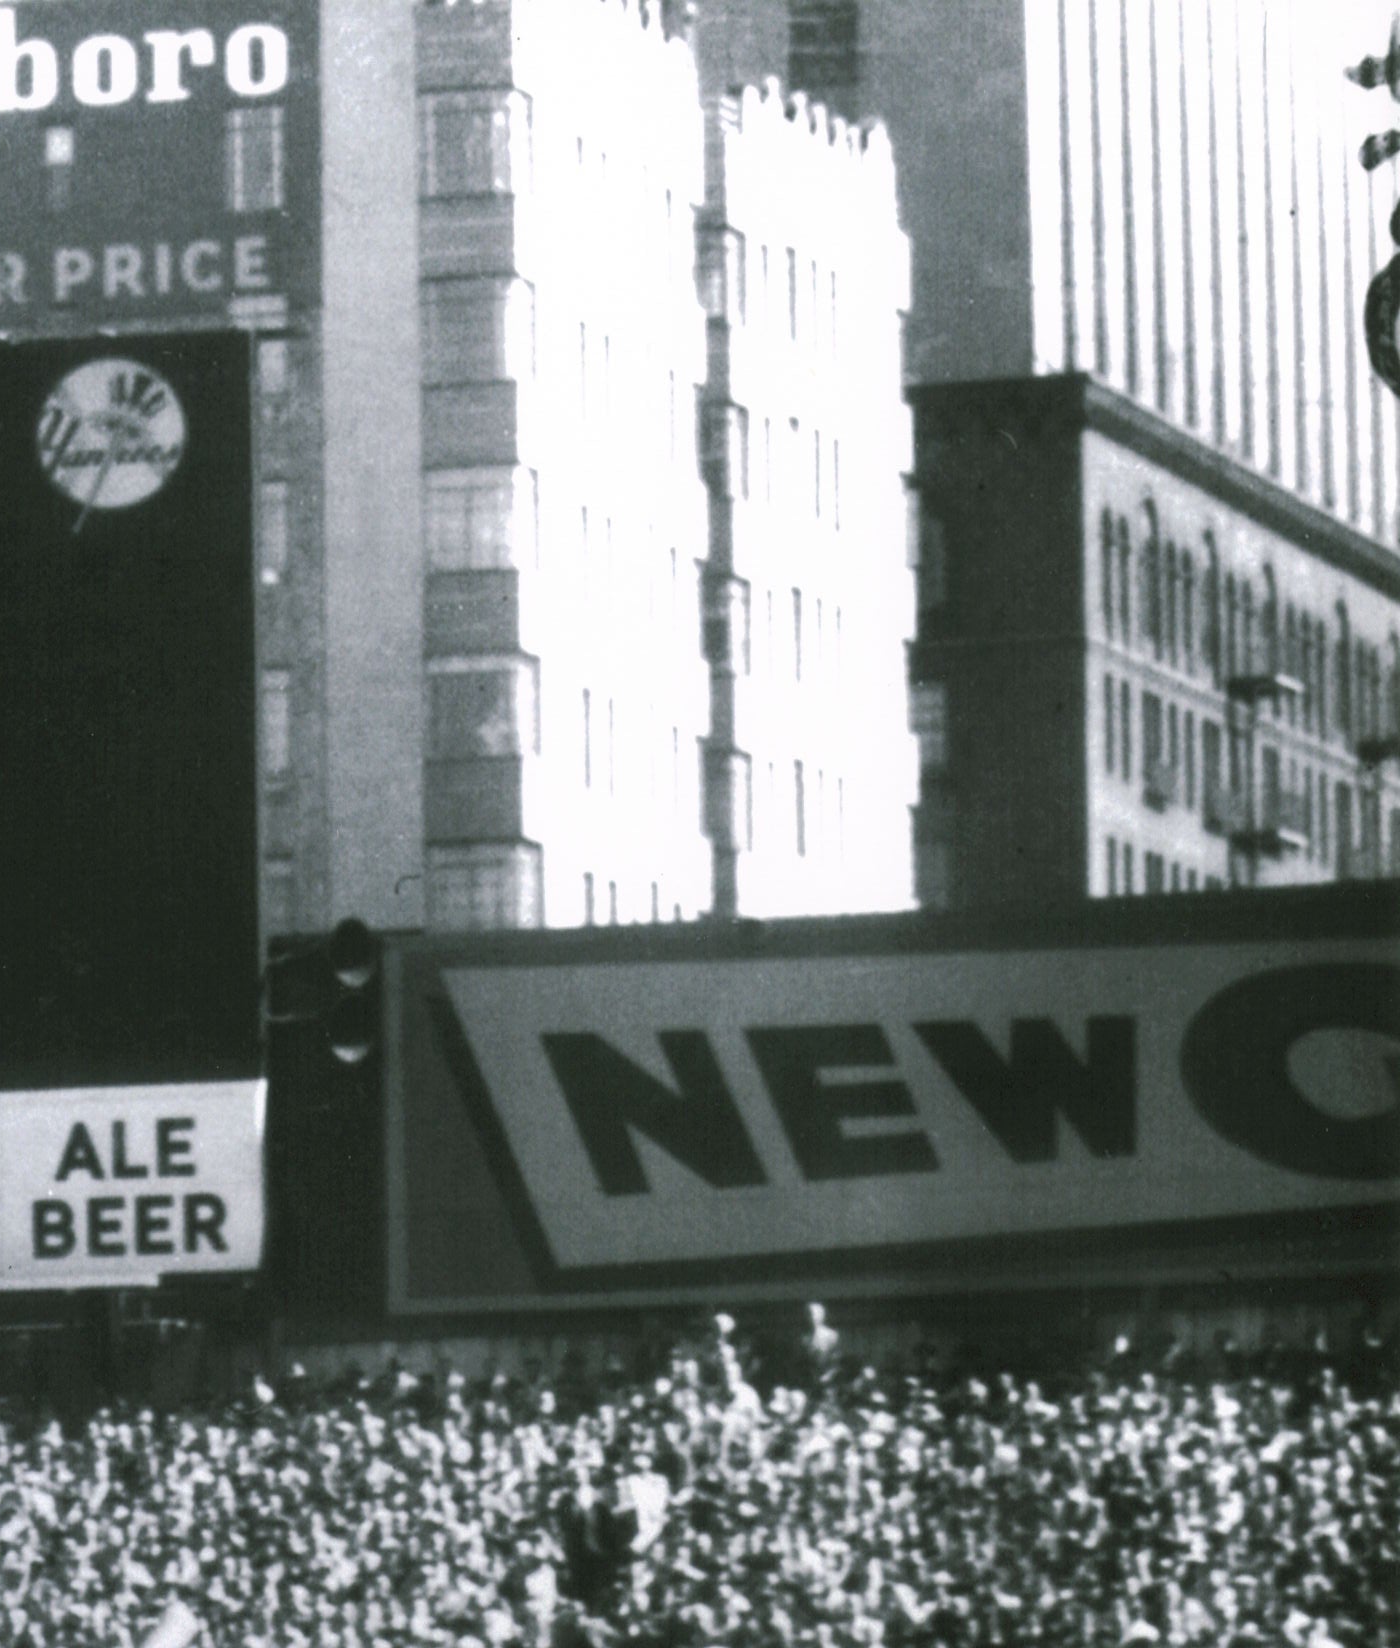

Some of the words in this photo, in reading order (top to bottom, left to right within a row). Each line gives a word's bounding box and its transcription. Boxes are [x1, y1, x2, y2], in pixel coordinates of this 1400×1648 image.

[52, 236, 272, 302] PRICE
[539, 1013, 1138, 1196] NEW
[55, 1117, 196, 1183] ALE
[31, 1193, 228, 1260] BEER
